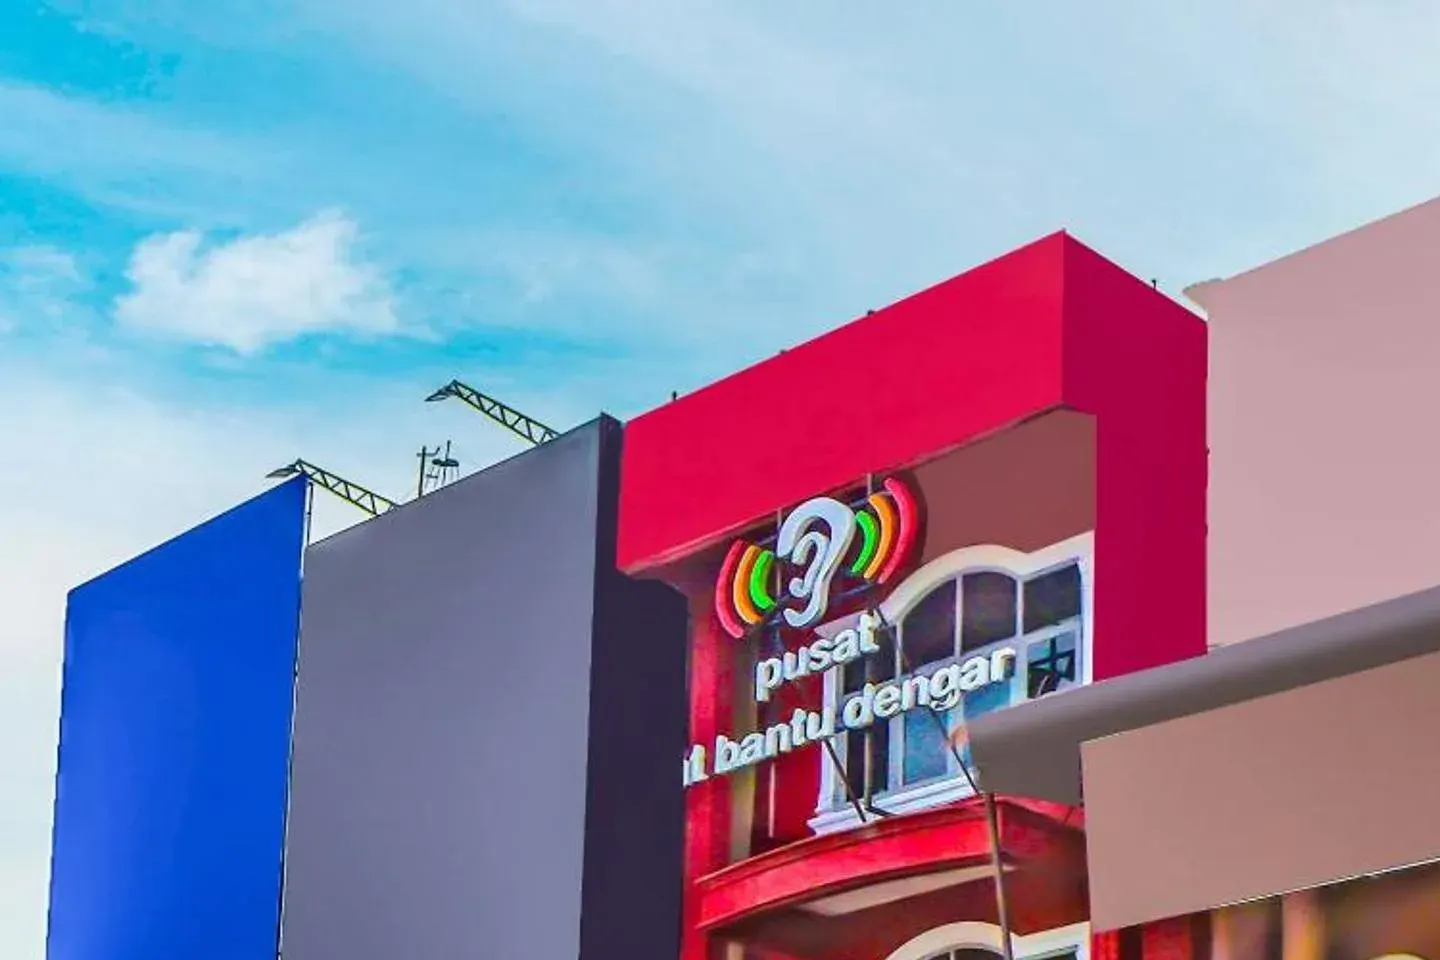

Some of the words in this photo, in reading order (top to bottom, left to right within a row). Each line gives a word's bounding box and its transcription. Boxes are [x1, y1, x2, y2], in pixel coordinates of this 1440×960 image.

[714, 707, 837, 774] bantu
[842, 646, 1016, 729] dengar
[756, 609, 881, 702] pusat
